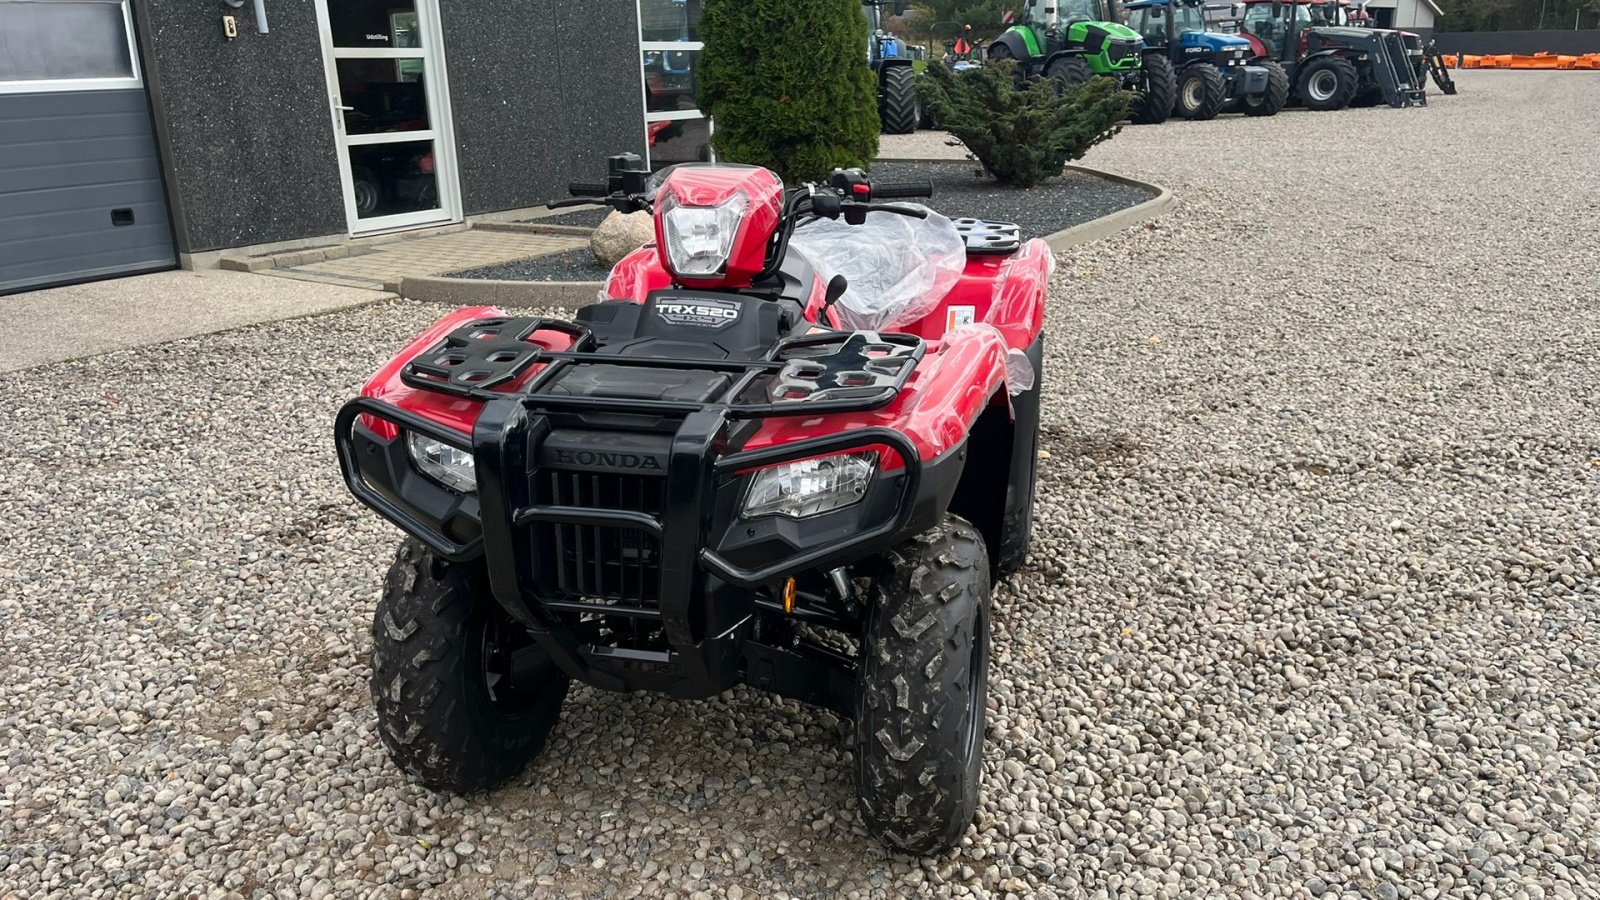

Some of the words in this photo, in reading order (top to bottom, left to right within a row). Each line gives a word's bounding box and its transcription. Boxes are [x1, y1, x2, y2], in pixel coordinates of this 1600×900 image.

[365, 33, 389, 41] Udstilling
[655, 304, 738, 319] TRX520
[554, 449, 663, 470] HONDA
